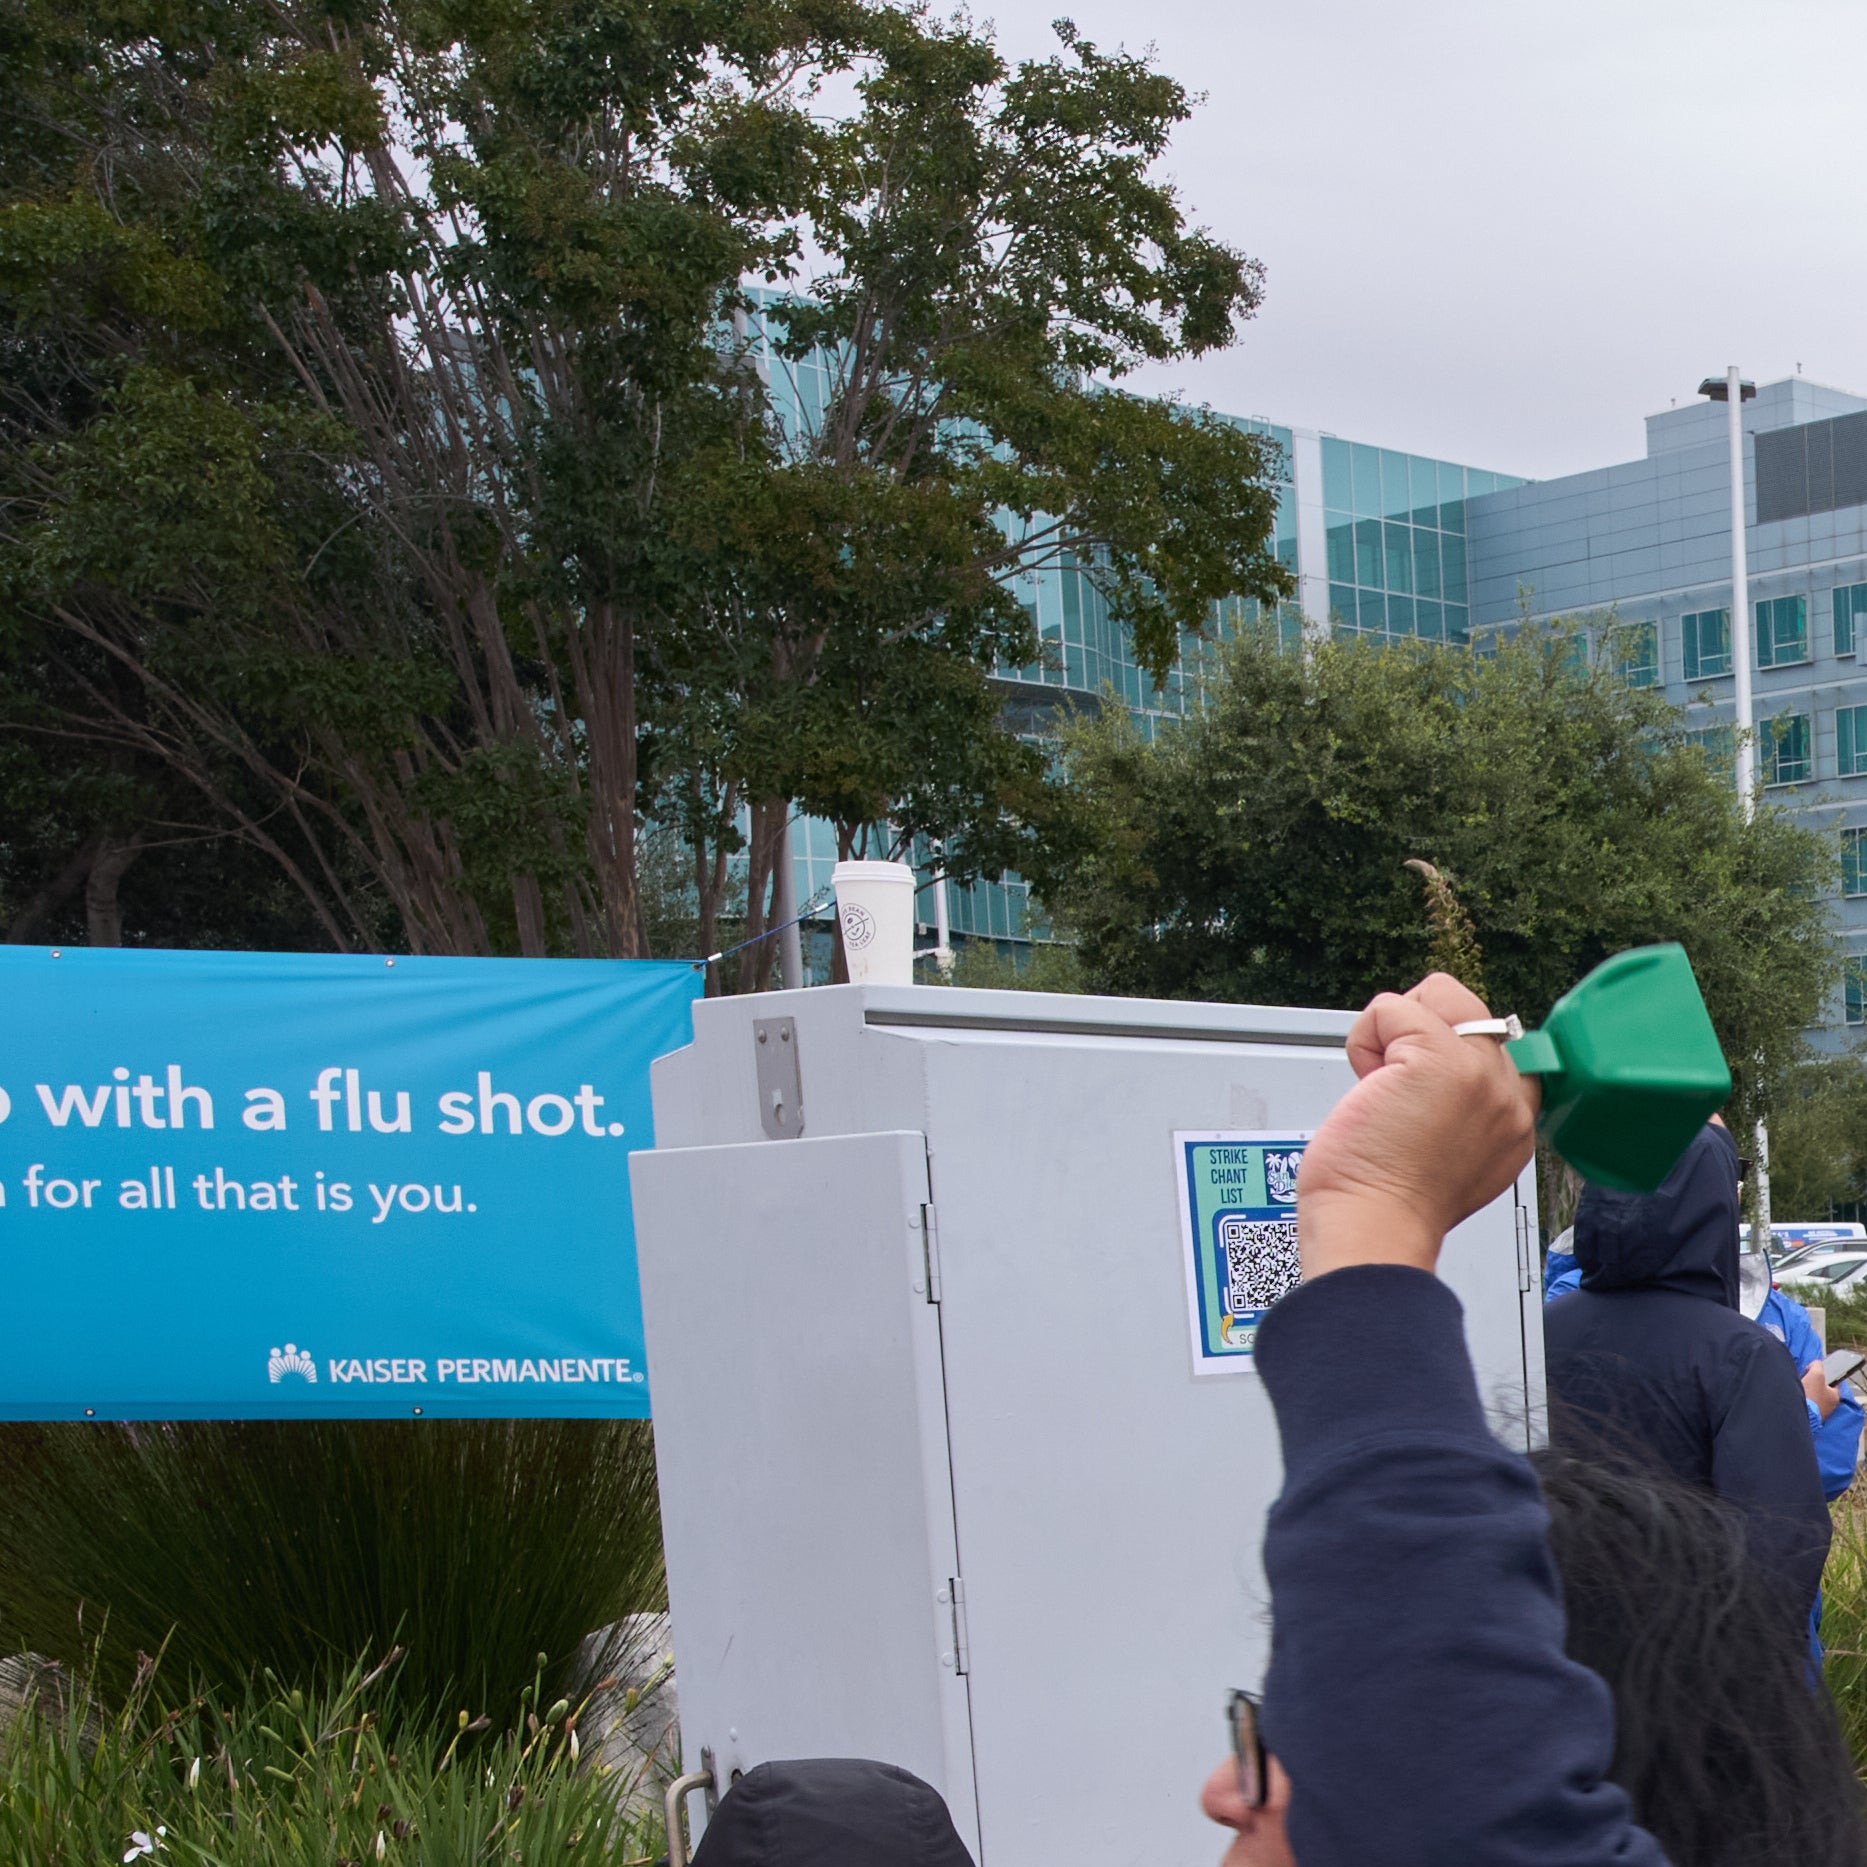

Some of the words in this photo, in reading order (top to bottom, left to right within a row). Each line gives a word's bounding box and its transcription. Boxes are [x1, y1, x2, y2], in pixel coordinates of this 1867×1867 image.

[36, 1063, 215, 1130] with
[242, 1086, 287, 1132] a
[310, 1067, 412, 1133] flu
[439, 1071, 625, 1137] shot.
[1209, 1149, 1248, 1164] STRIKE
[1211, 1168, 1247, 1184] CHANT
[22, 1164, 101, 1210] for
[119, 1166, 176, 1210] all
[193, 1167, 299, 1212] that
[315, 1171, 354, 1212] is
[369, 1183, 478, 1225] you.
[1221, 1188, 1243, 1204] LIST
[330, 1358, 427, 1383] KAISER
